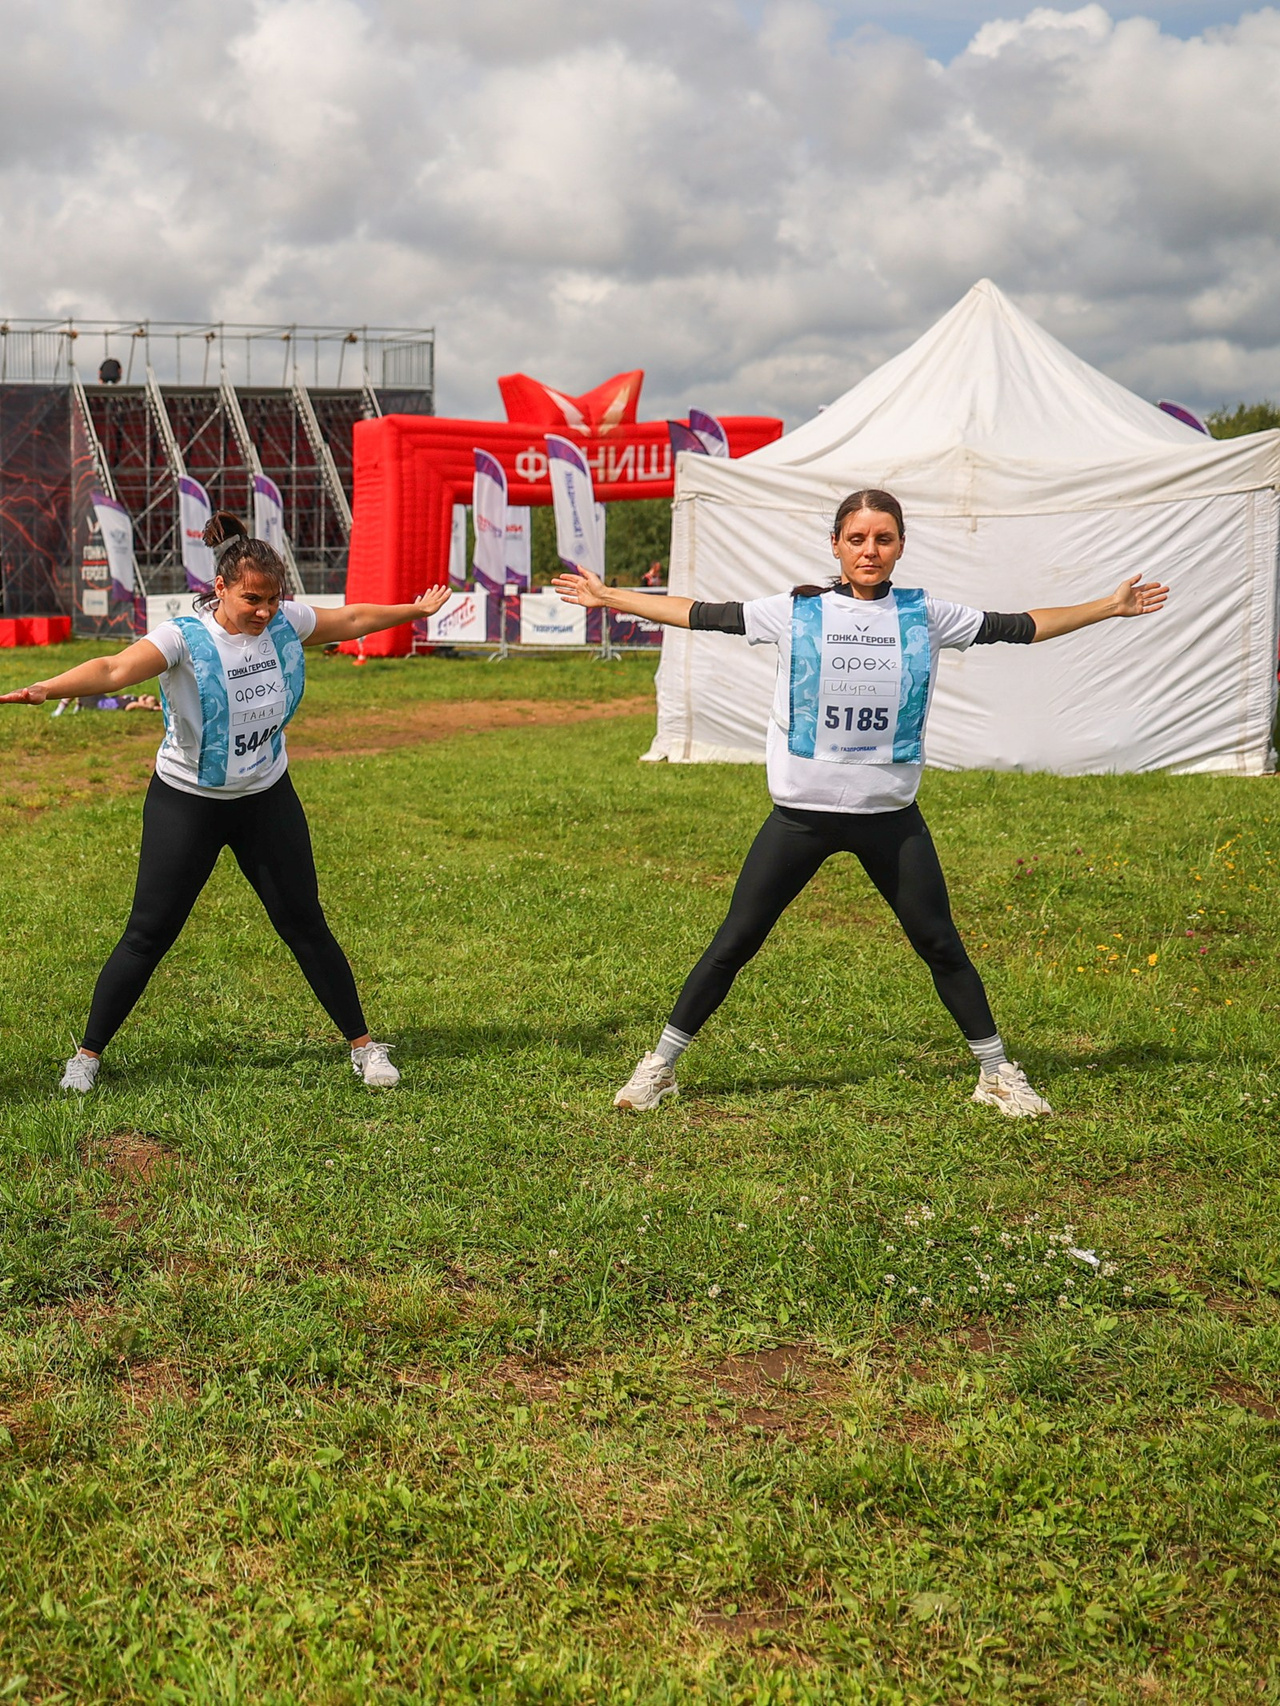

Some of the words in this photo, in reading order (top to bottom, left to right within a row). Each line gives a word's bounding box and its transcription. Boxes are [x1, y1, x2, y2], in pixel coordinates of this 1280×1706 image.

[515, 443, 672, 484] ФНИШ
[827, 634, 858, 642] ГОНКА
[861, 635, 896, 644] ГЕРОЕВ
[228, 665, 248, 677] ГОНКА
[248, 659, 277, 672] ГЕРОЕВ
[825, 706, 889, 732] 5185
